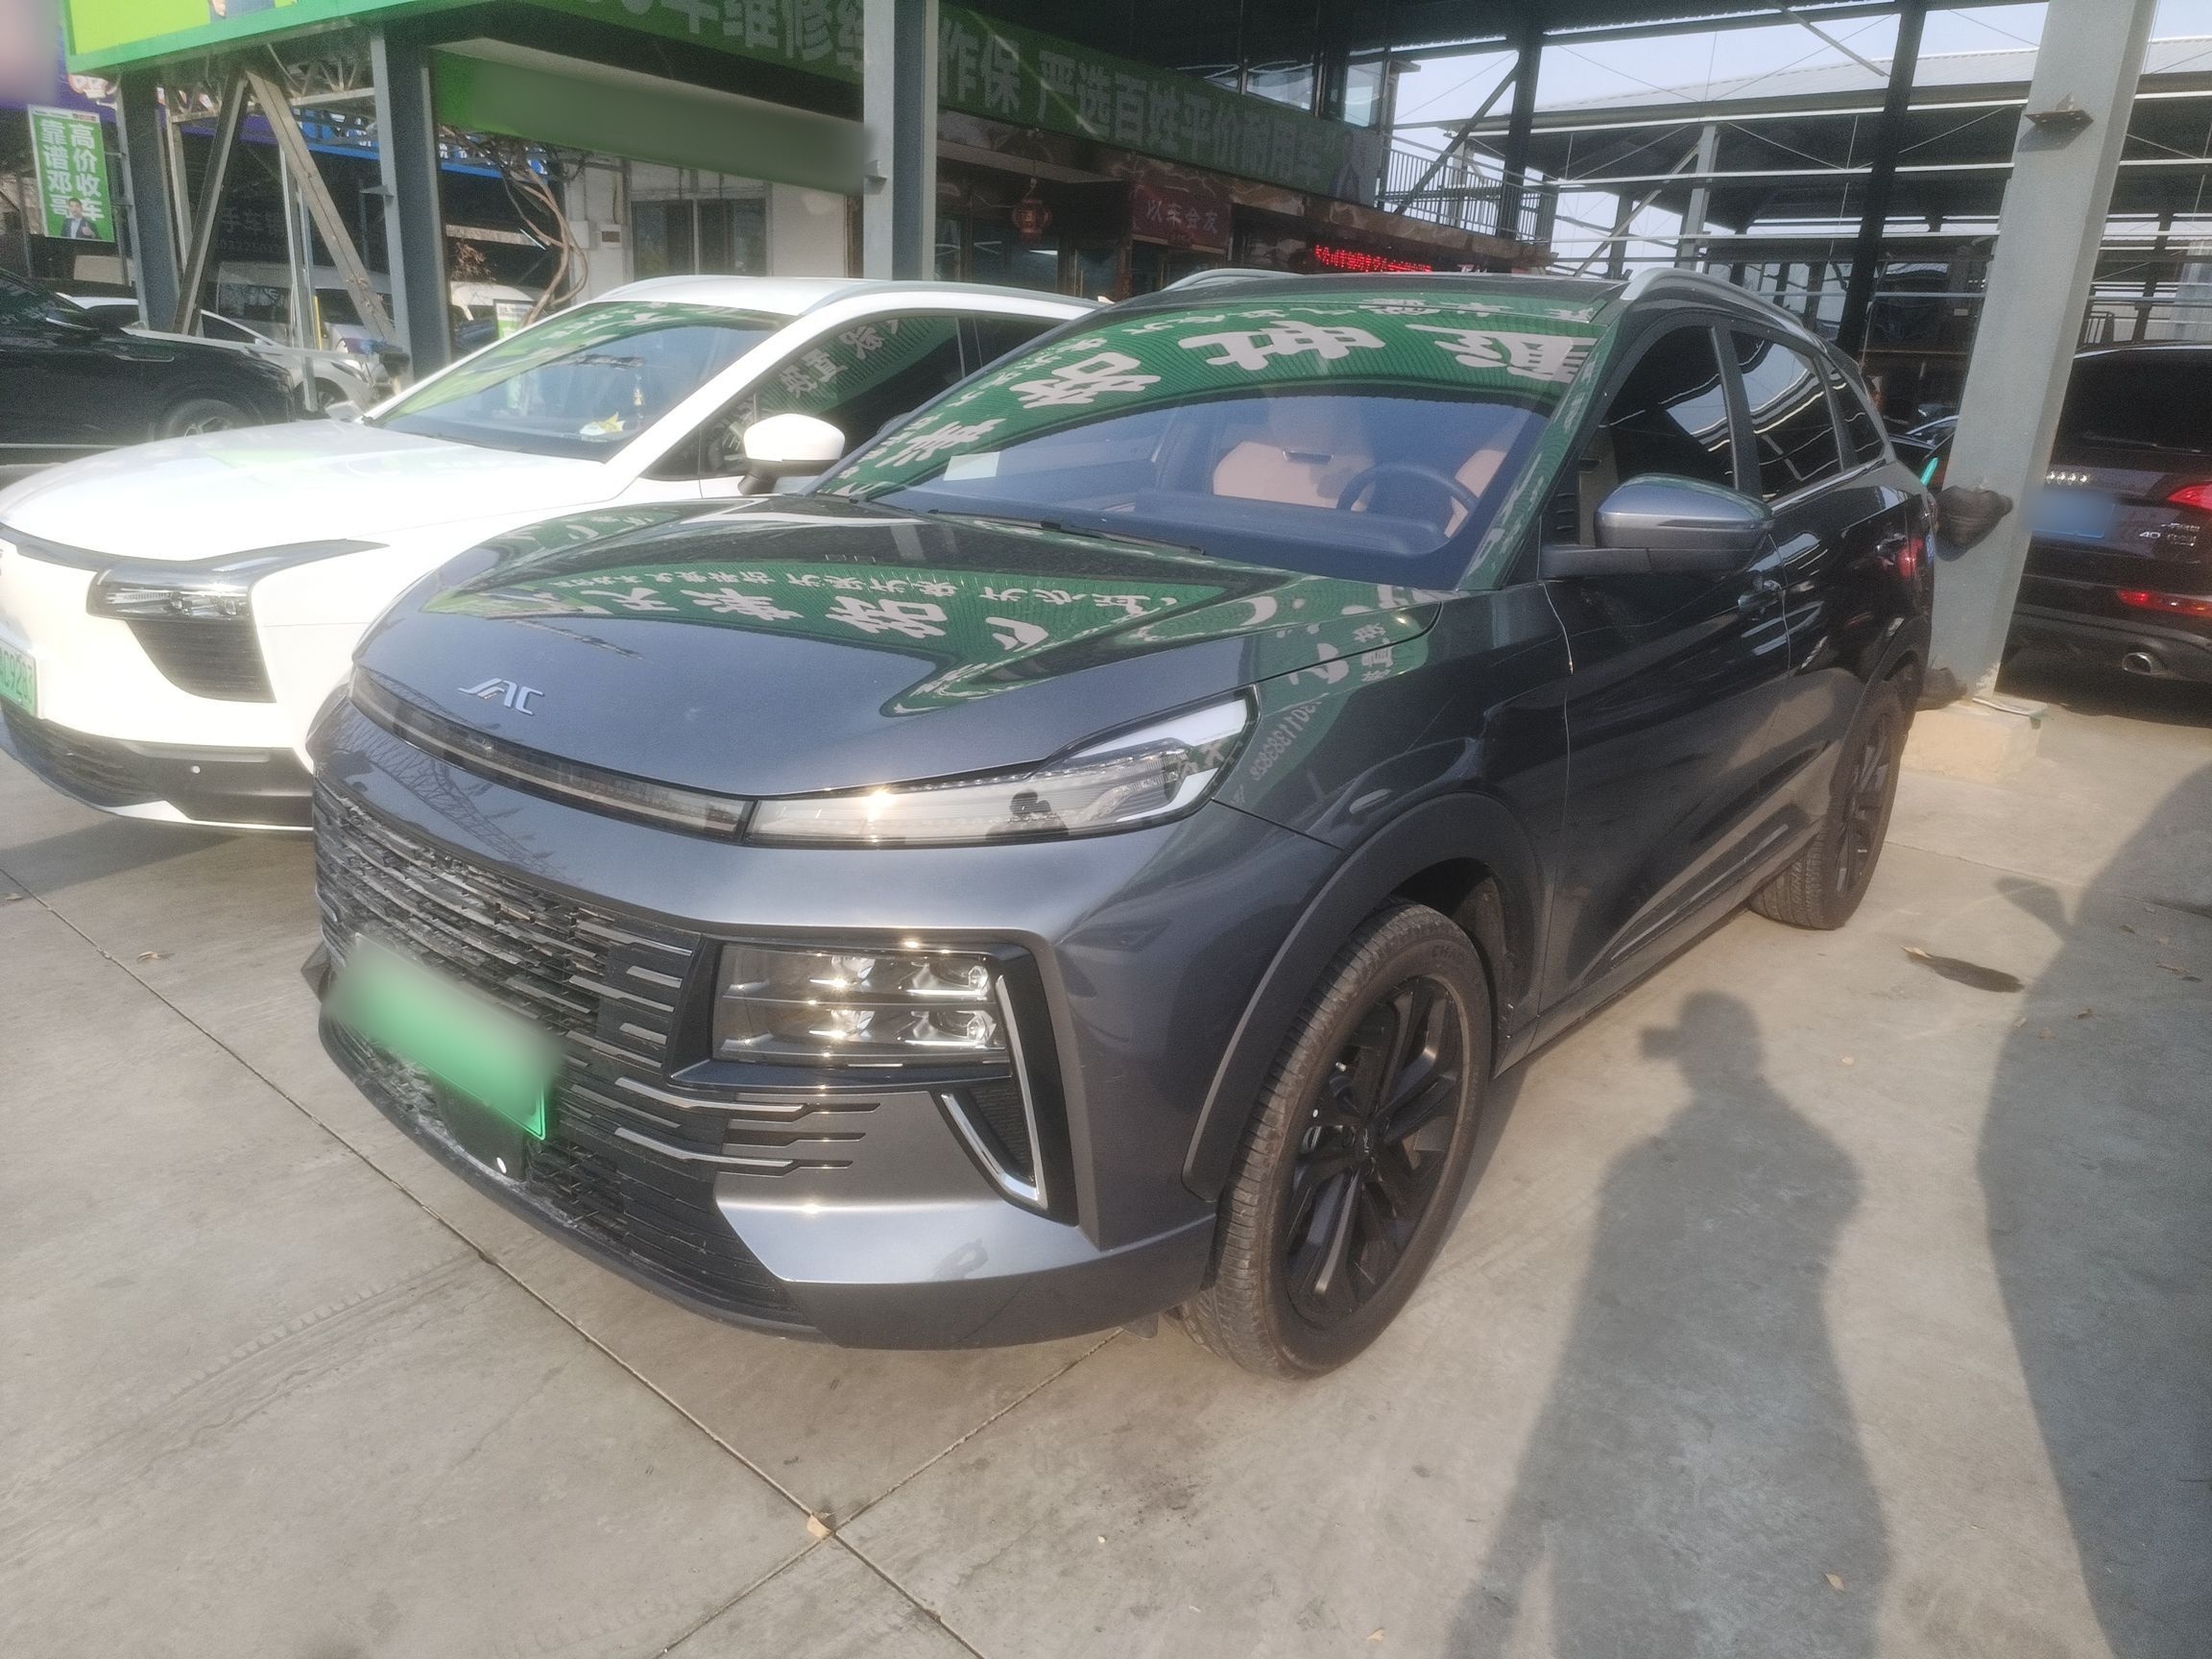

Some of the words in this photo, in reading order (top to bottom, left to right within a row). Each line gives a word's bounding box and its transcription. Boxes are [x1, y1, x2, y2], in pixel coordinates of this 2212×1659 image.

[939, 19, 1022, 114] 作保
[39, 118, 73, 219] 靠谱邓哥
[68, 123, 105, 222] 高价收车
[459, 677, 545, 716] JAC
